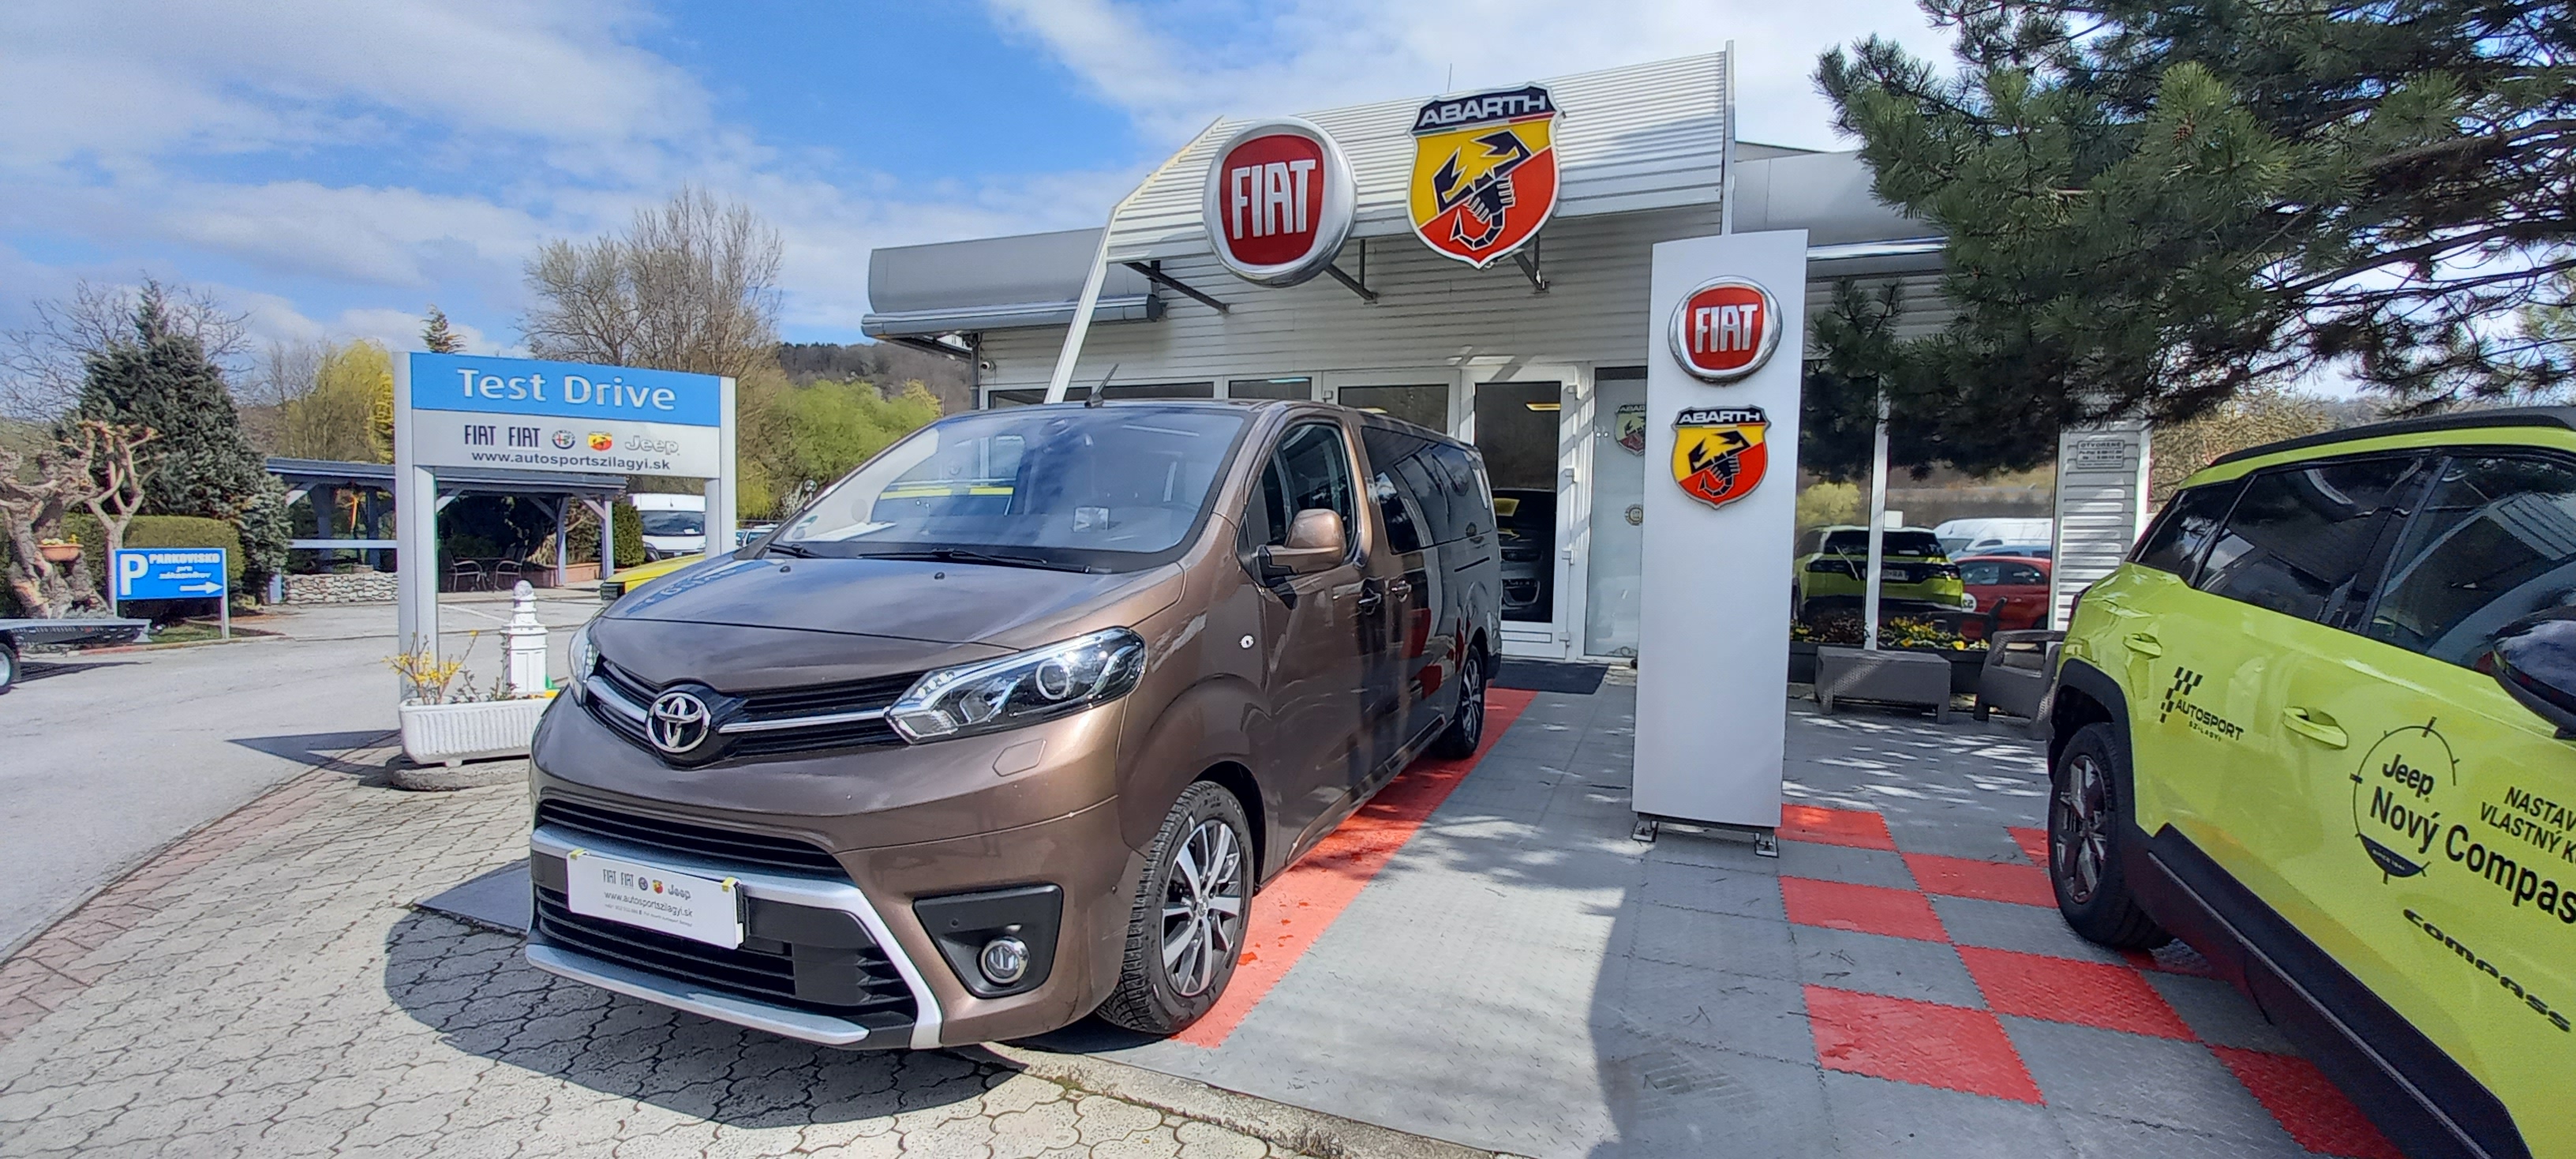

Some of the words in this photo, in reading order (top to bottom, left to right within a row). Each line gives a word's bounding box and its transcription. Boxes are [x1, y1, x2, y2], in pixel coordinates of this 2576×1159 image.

[1418, 94, 1547, 127] ABARTH
[1230, 159, 1316, 240] FIAT
[1694, 303, 1759, 354] FIAT
[457, 368, 547, 402] Test
[564, 375, 676, 411] Drive
[1678, 411, 1761, 424] ABARTH
[464, 425, 496, 446] FIAT
[508, 427, 541, 448] FIAT
[624, 434, 680, 456] Jeep
[472, 451, 670, 471] www.autosportszilagyi.sk
[120, 553, 148, 595] P
[148, 553, 220, 564] PARKOVISKO
[2175, 699, 2244, 741] AUTOSPORT
[2382, 754, 2434, 798] Jeep
[2369, 786, 2443, 854] Nový
[2481, 801, 2563, 853] VLASTNÝ
[603, 868, 616, 885] FIAT
[620, 871, 634, 887] FIAT
[668, 883, 691, 901] Jeep
